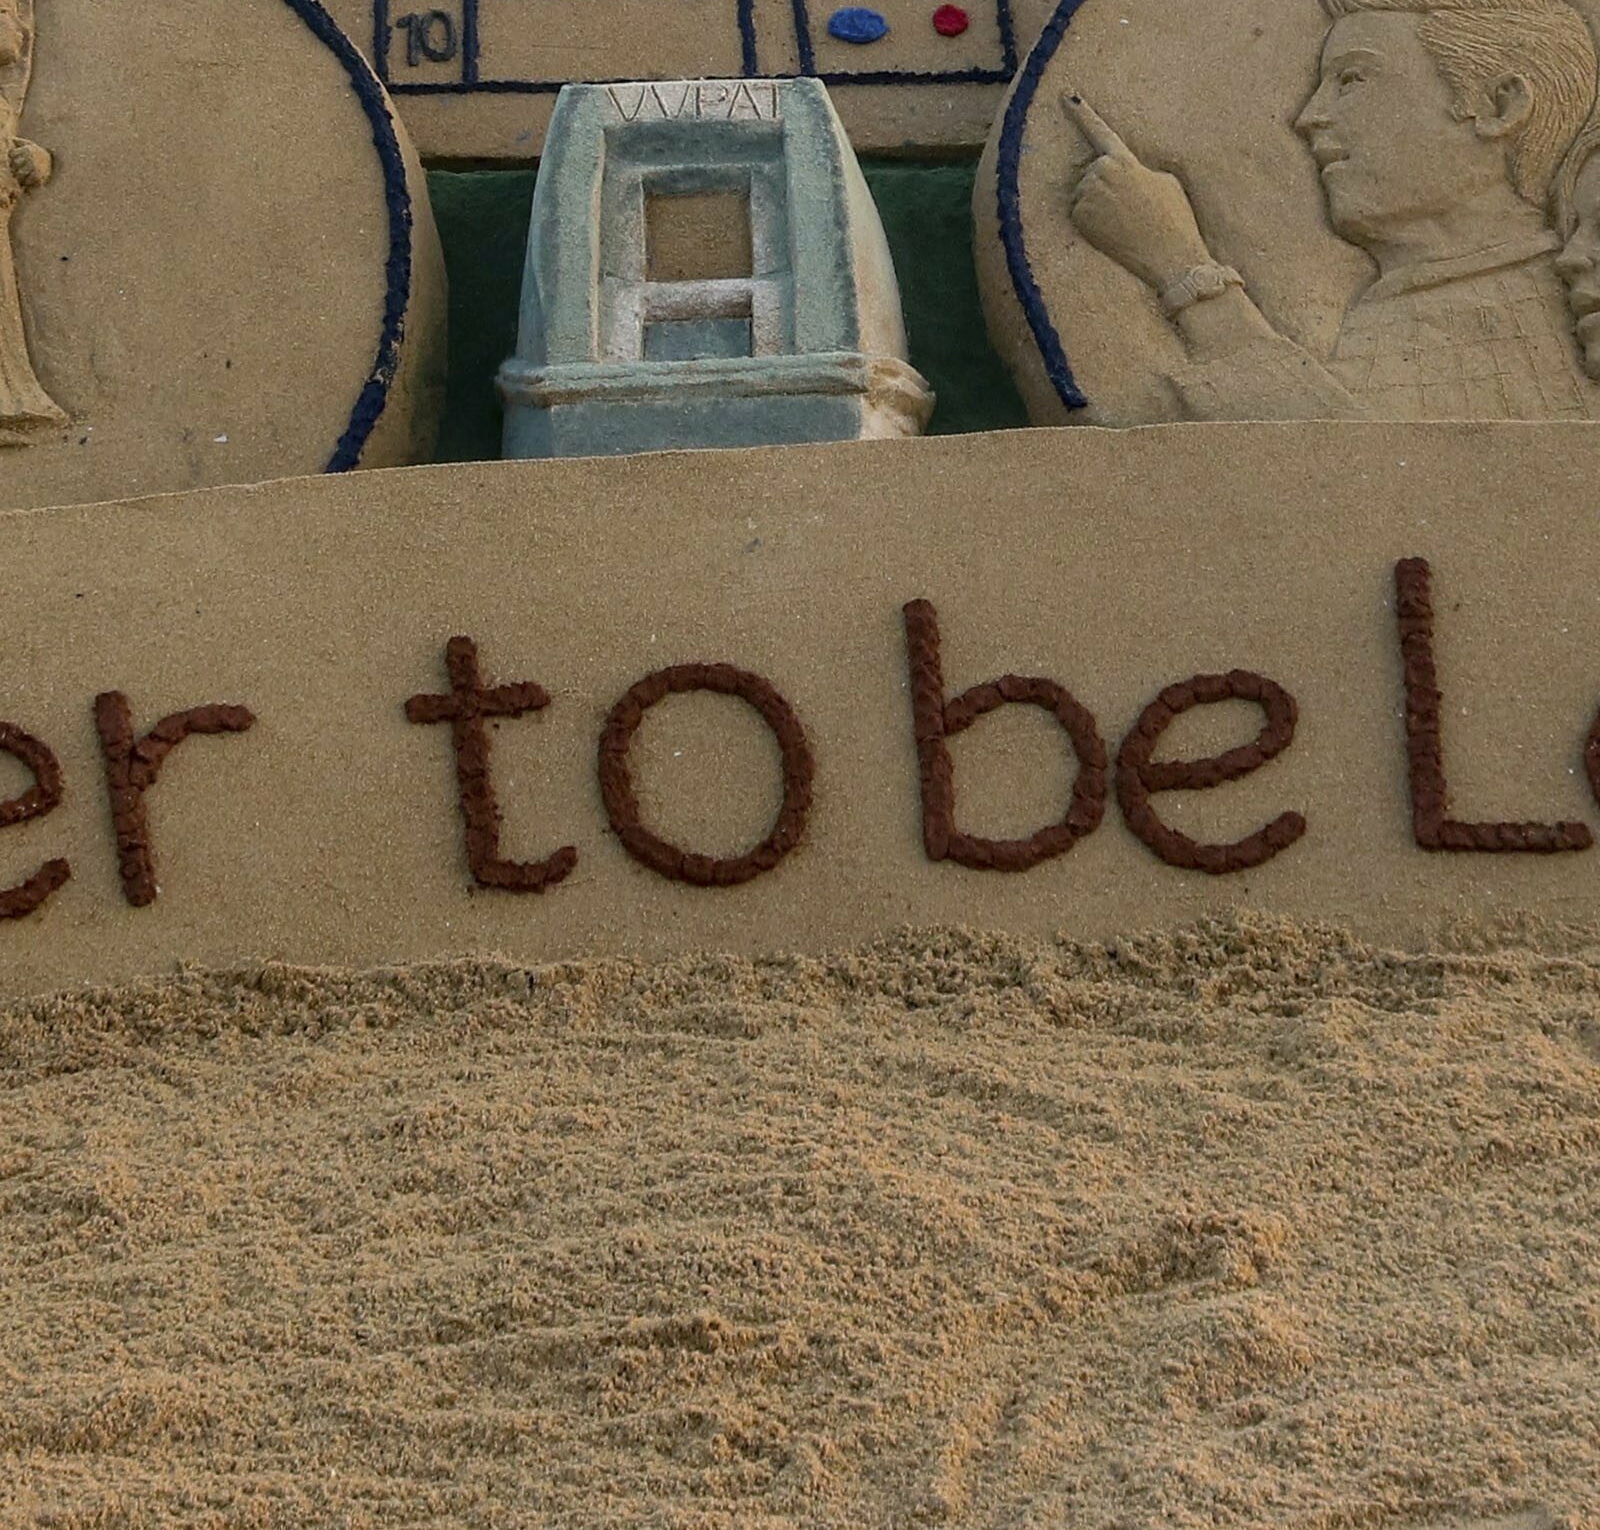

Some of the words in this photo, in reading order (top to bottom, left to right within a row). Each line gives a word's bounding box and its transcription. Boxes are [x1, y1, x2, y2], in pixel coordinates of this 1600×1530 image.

[396, 10, 457, 67] 10
[606, 82, 779, 122] VVPAT
[403, 633, 817, 895] to
[901, 598, 1308, 873] be
